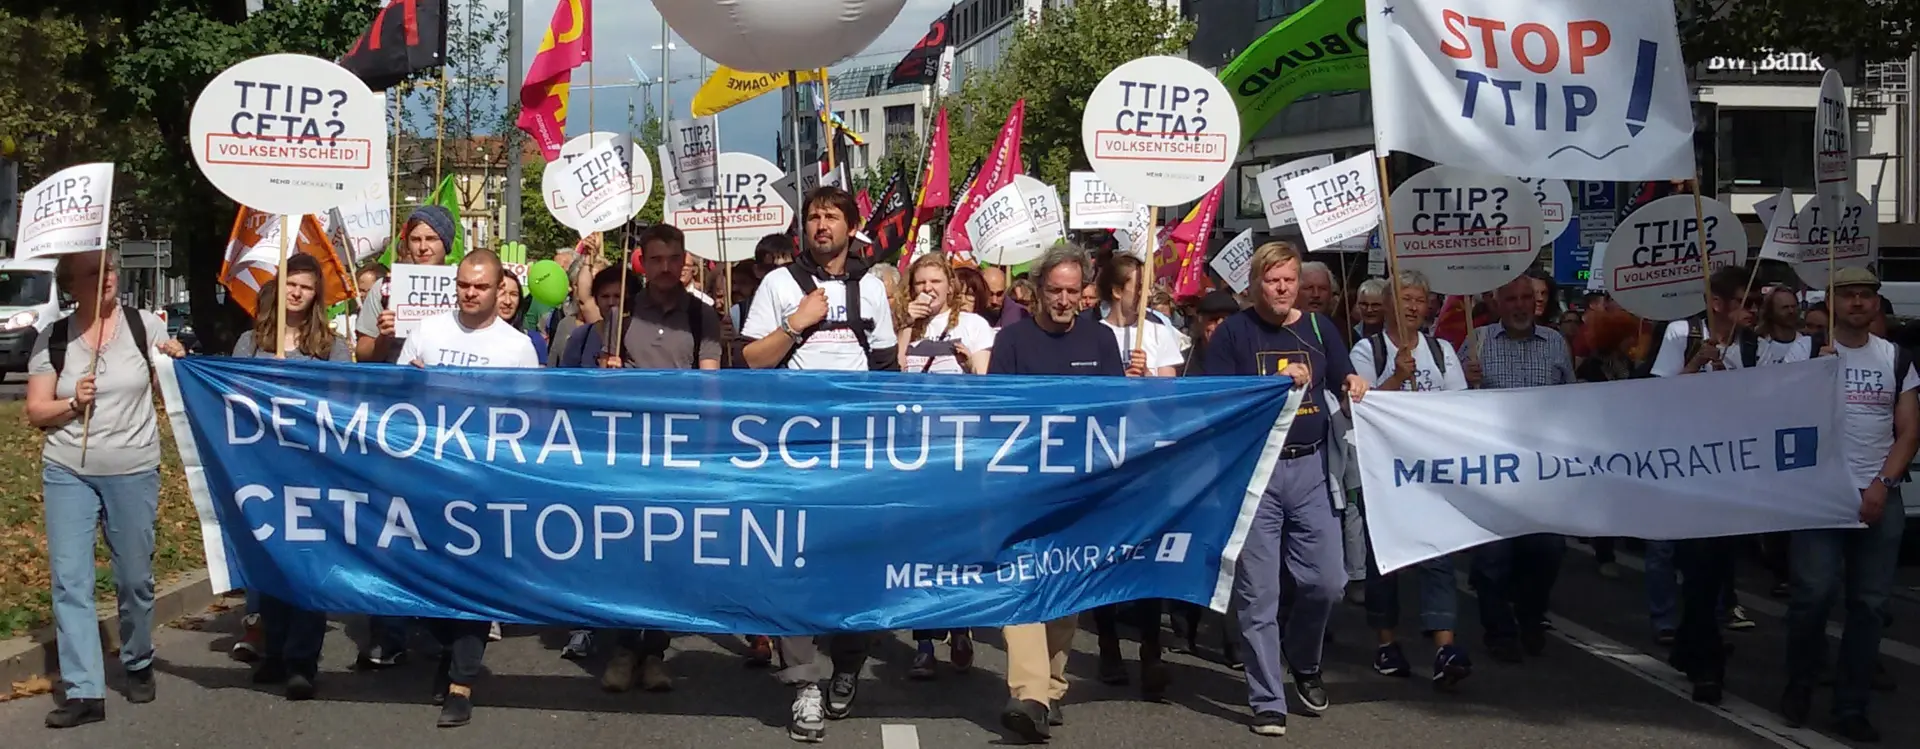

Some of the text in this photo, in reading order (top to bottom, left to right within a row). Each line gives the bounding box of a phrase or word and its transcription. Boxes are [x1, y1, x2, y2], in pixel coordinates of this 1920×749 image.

[1439, 8, 1611, 75] STOP
[234, 80, 348, 117] TTIP?
[1119, 80, 1210, 114] TTIP?
[1455, 69, 1598, 132] TTIP
[231, 111, 346, 148] CETA?
[680, 125, 710, 143] TTIP?
[1116, 110, 1207, 142] CETA?
[219, 143, 359, 160] VOLKSENTSCHEID!
[1105, 139, 1218, 154] VOLKSENTSCHEID!
[37, 176, 91, 207] TTIP?
[1306, 170, 1360, 201] TTIP?
[1412, 187, 1508, 211] TTIP?
[34, 195, 92, 222] CETA?
[975, 196, 1009, 229] TTIP?
[1313, 186, 1367, 216] CETA?
[1811, 206, 1861, 225] TP?
[683, 213, 776, 226] VOLKSENTSCHEID!
[979, 207, 1014, 237] CETA?
[1412, 213, 1508, 237] CETA?
[1634, 216, 1718, 244] TTIP?
[1403, 235, 1521, 251] VOLKSENTSCHEID!
[1632, 240, 1717, 268] CETA?
[1577, 271, 1591, 280] FR
[1845, 368, 1882, 383] TIP?
[225, 393, 701, 468] DEMOKRATIE
[730, 403, 1127, 474] SCHÜTZEN
[1393, 452, 1521, 488] MEHR
[234, 483, 807, 569] CETA STOPPEN!
[886, 562, 984, 589] MEHR
